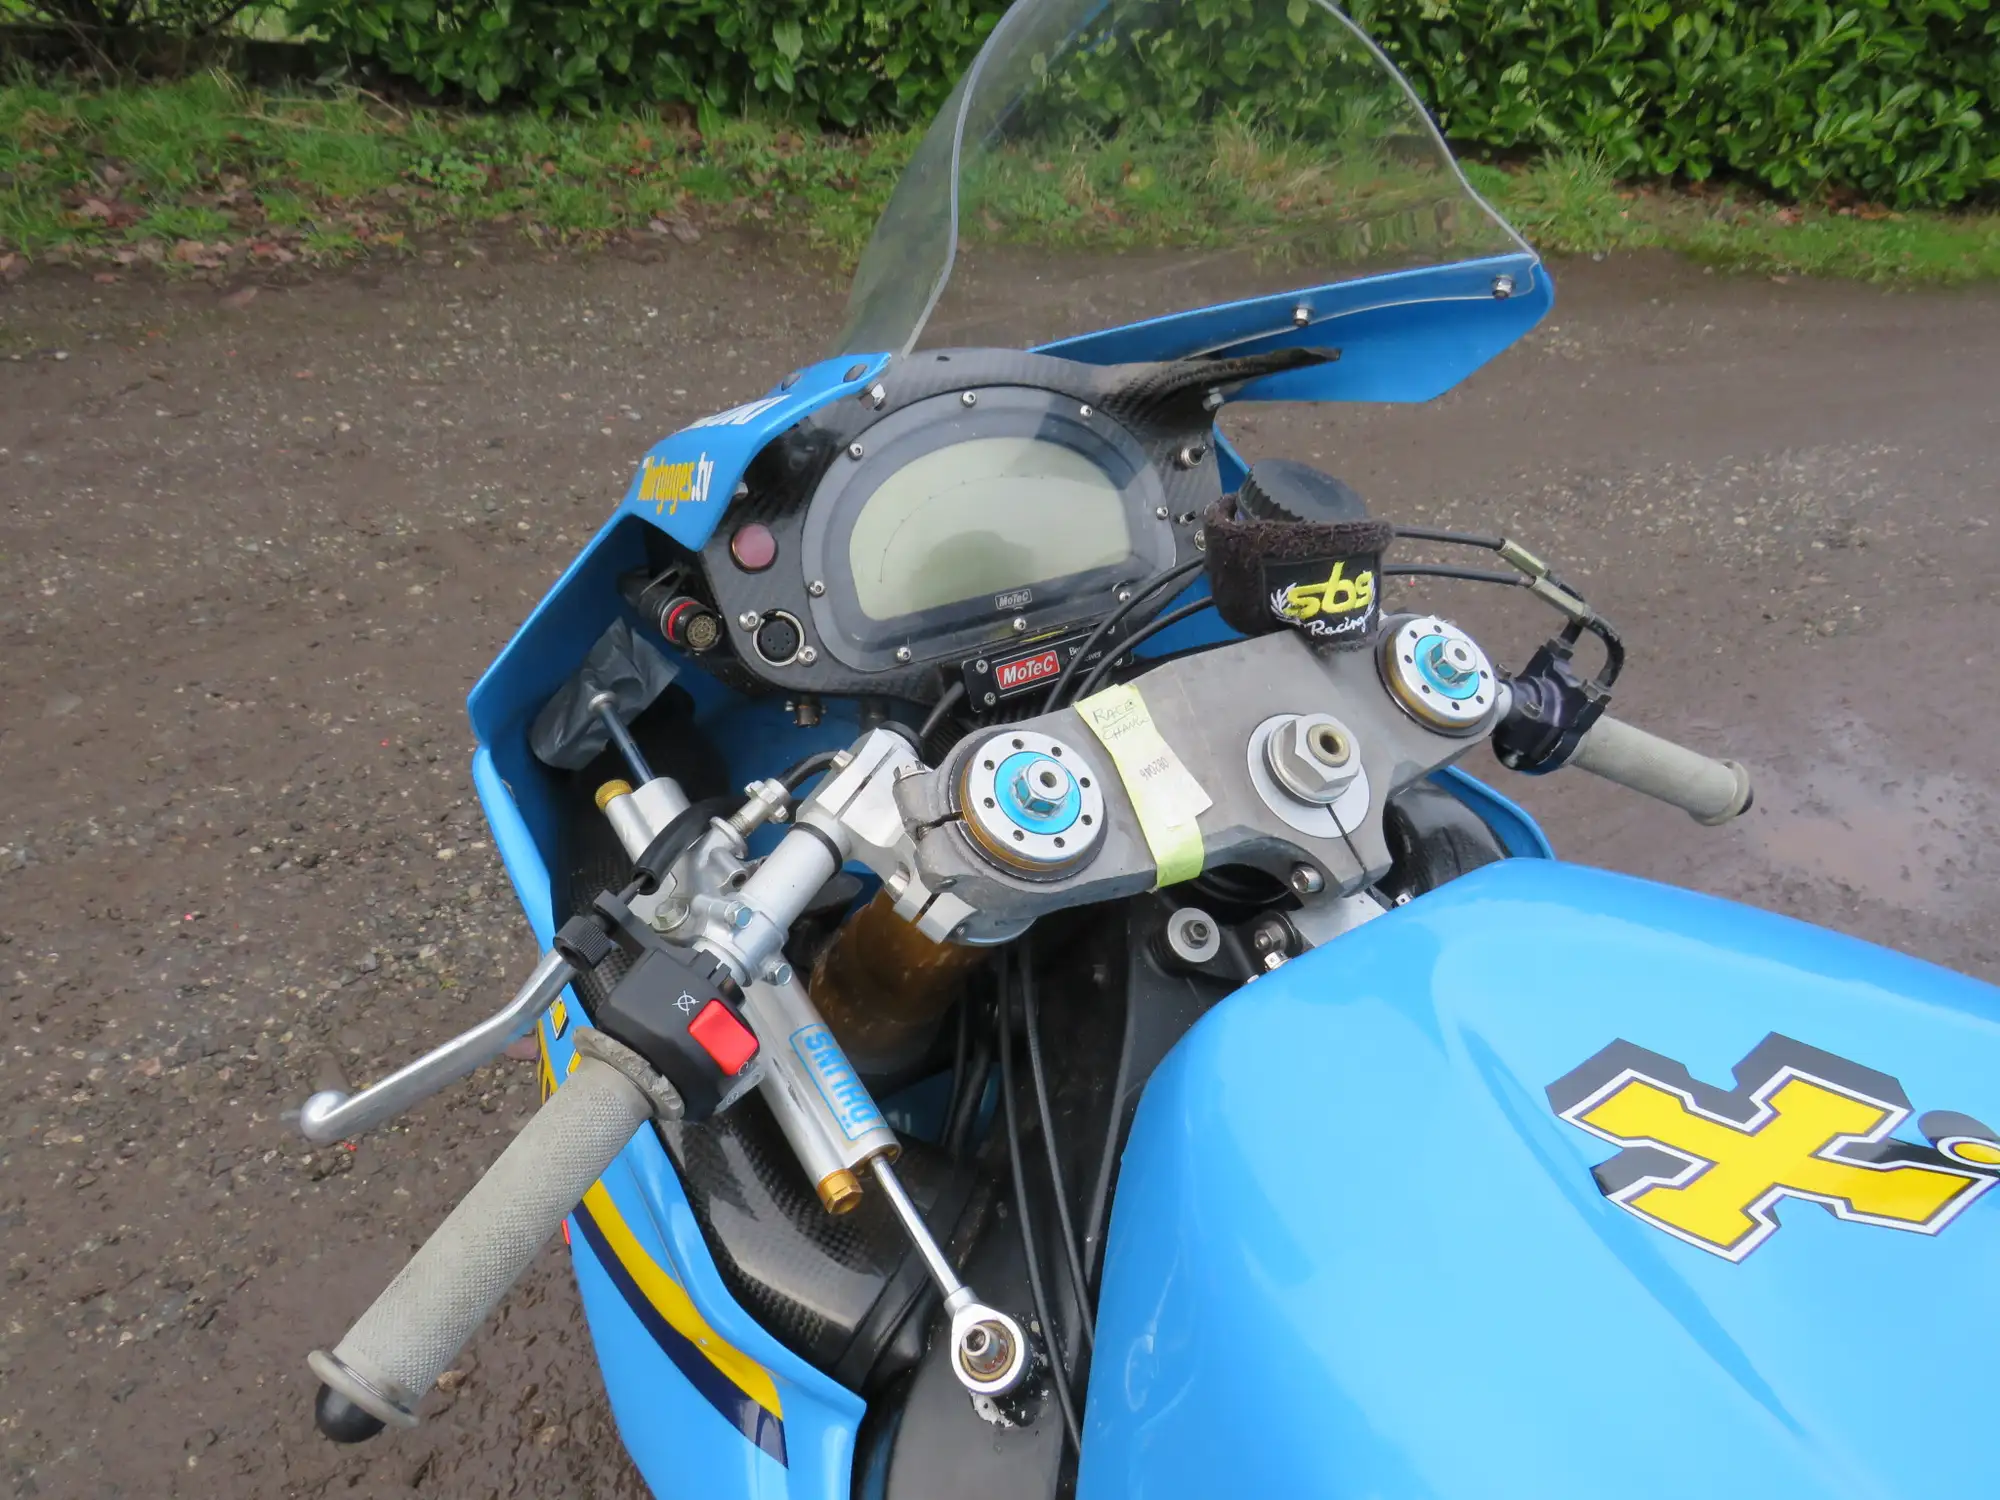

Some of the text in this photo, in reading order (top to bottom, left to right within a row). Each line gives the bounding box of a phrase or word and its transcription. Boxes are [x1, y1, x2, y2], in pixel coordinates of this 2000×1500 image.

[999, 591, 1029, 607] MoTeC
[1305, 617, 1366, 636] Racing
[1003, 655, 1054, 685] MoTeC
[804, 1031, 878, 1129] ÖHLINS
